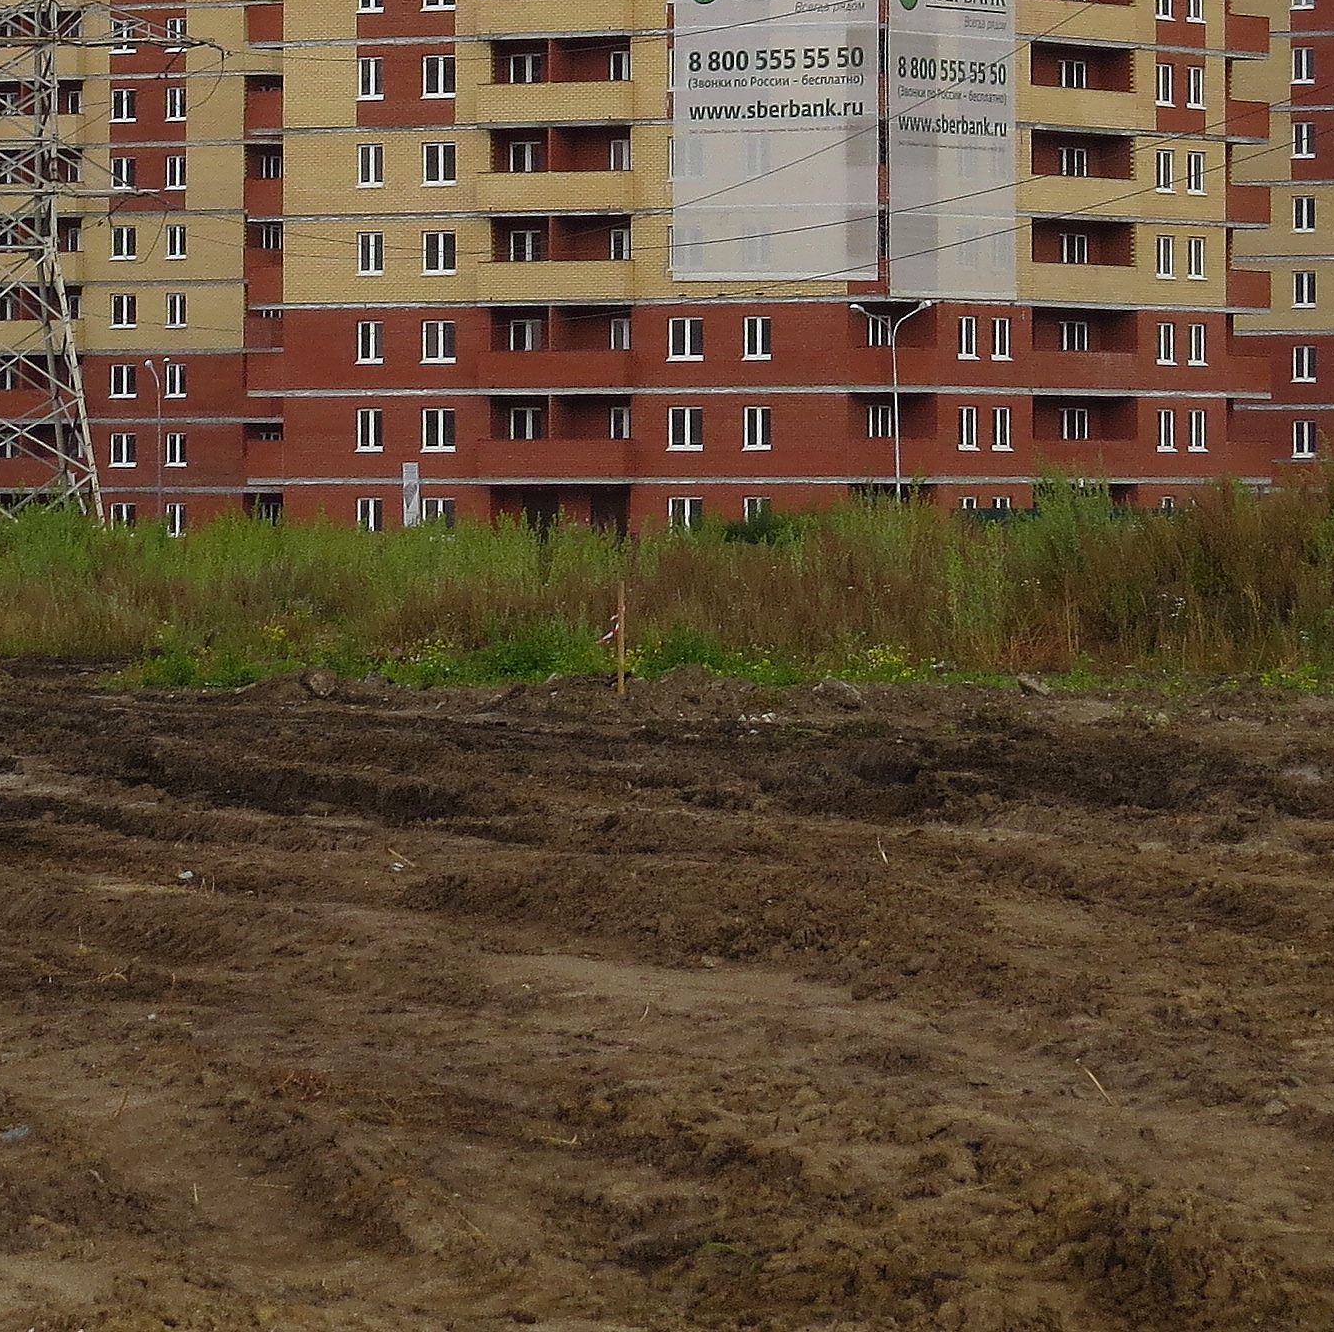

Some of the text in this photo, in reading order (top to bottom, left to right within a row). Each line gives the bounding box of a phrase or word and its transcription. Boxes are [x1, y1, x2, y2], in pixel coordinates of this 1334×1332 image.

[688, 46, 864, 72] 8 800 555 55 50
[898, 56, 1006, 85] 8 800 555 55 50
[688, 77, 732, 90] (Звонки
[734, 77, 748, 87] по
[750, 75, 790, 87] России
[801, 73, 864, 86] бесплатно)
[689, 98, 864, 120] www.sberbank.ru
[898, 113, 1008, 137] www.sberbank.ru
